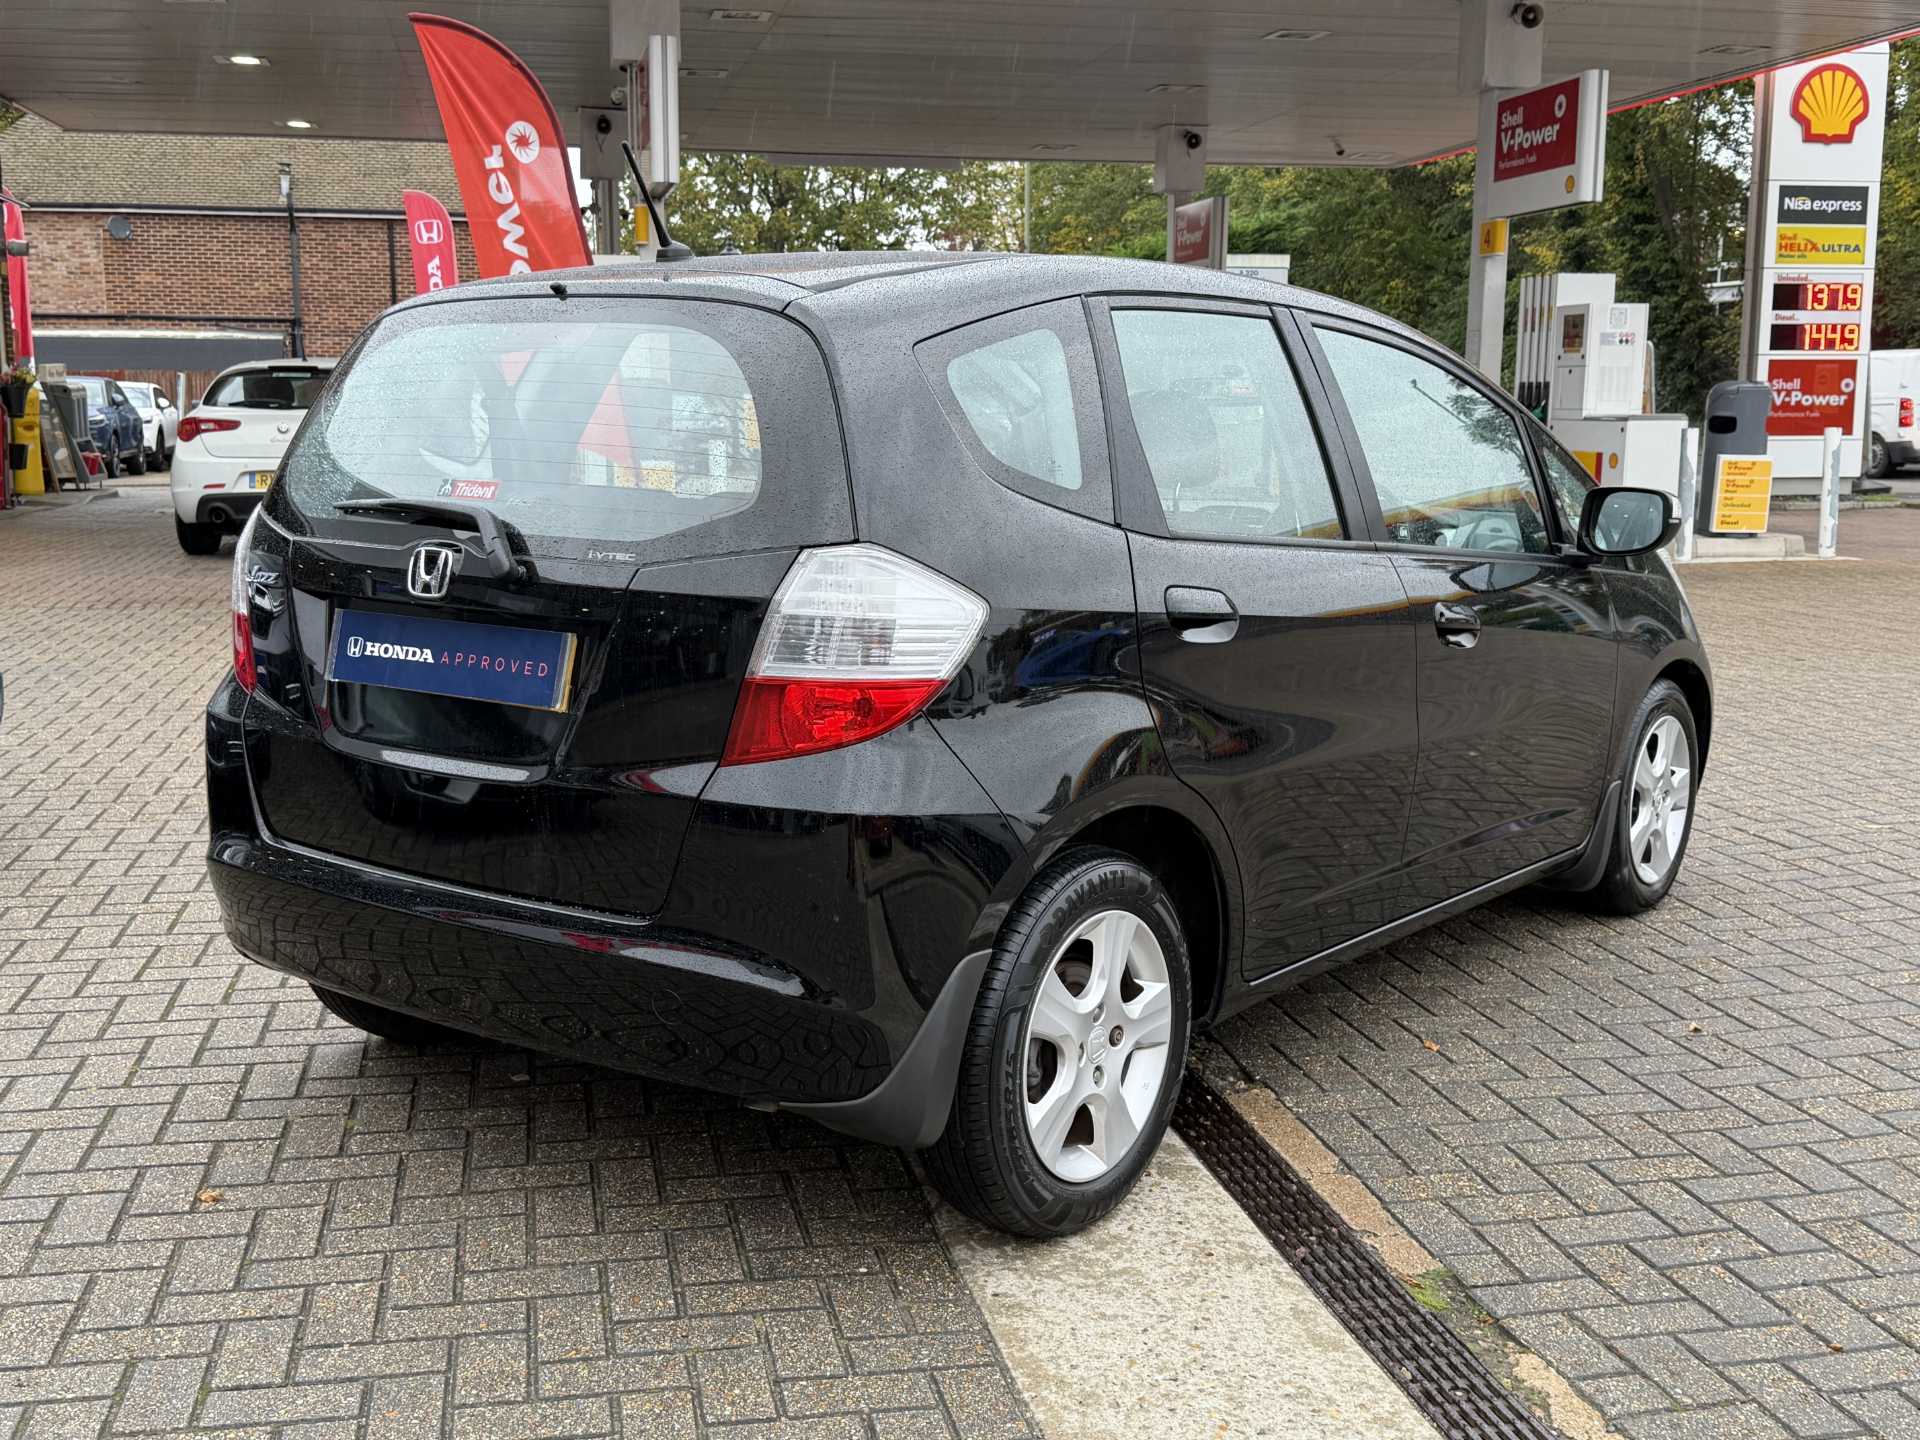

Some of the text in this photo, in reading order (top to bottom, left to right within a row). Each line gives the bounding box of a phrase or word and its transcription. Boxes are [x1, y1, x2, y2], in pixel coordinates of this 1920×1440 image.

[1501, 107, 1525, 129] Shell
[1501, 123, 1561, 154] V-Power
[1784, 196, 1863, 213] Nisa express
[1779, 239, 1862, 254] HELIX ULTRA
[1807, 284, 1861, 311] 137.9
[1804, 324, 1859, 350] 144.9
[1772, 378, 1801, 390] Shell
[1772, 391, 1848, 406] V-Power
[455, 482, 496, 499] Trident
[364, 641, 549, 677] HONDA APPROVED
